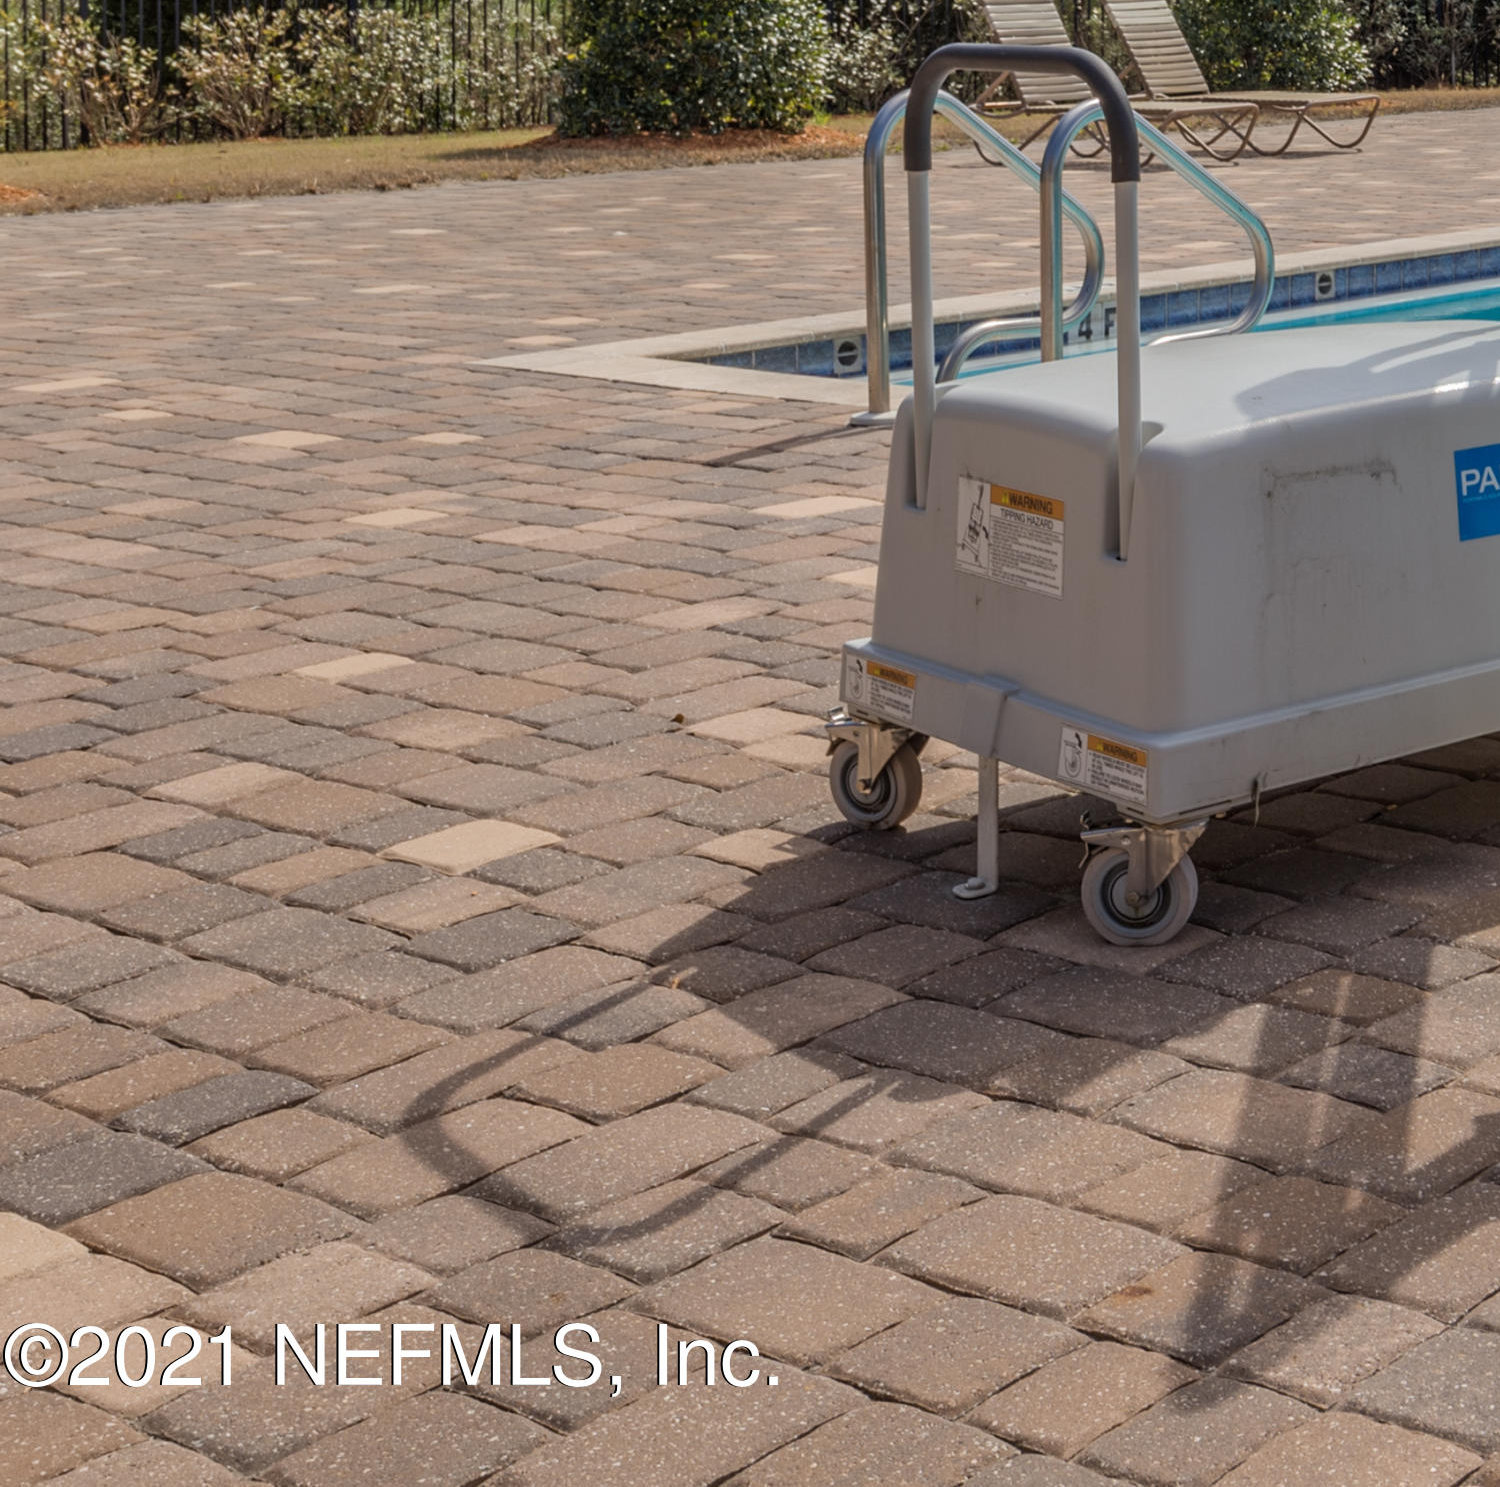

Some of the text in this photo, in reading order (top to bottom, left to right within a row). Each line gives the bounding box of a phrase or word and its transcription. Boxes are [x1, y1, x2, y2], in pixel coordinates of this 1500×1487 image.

[1078, 307, 1117, 340] 4 F
[1008, 493, 1053, 514] WARNING
[1000, 508, 1054, 530] TIPPING HAZARD
[1103, 742, 1138, 762] WARNING
